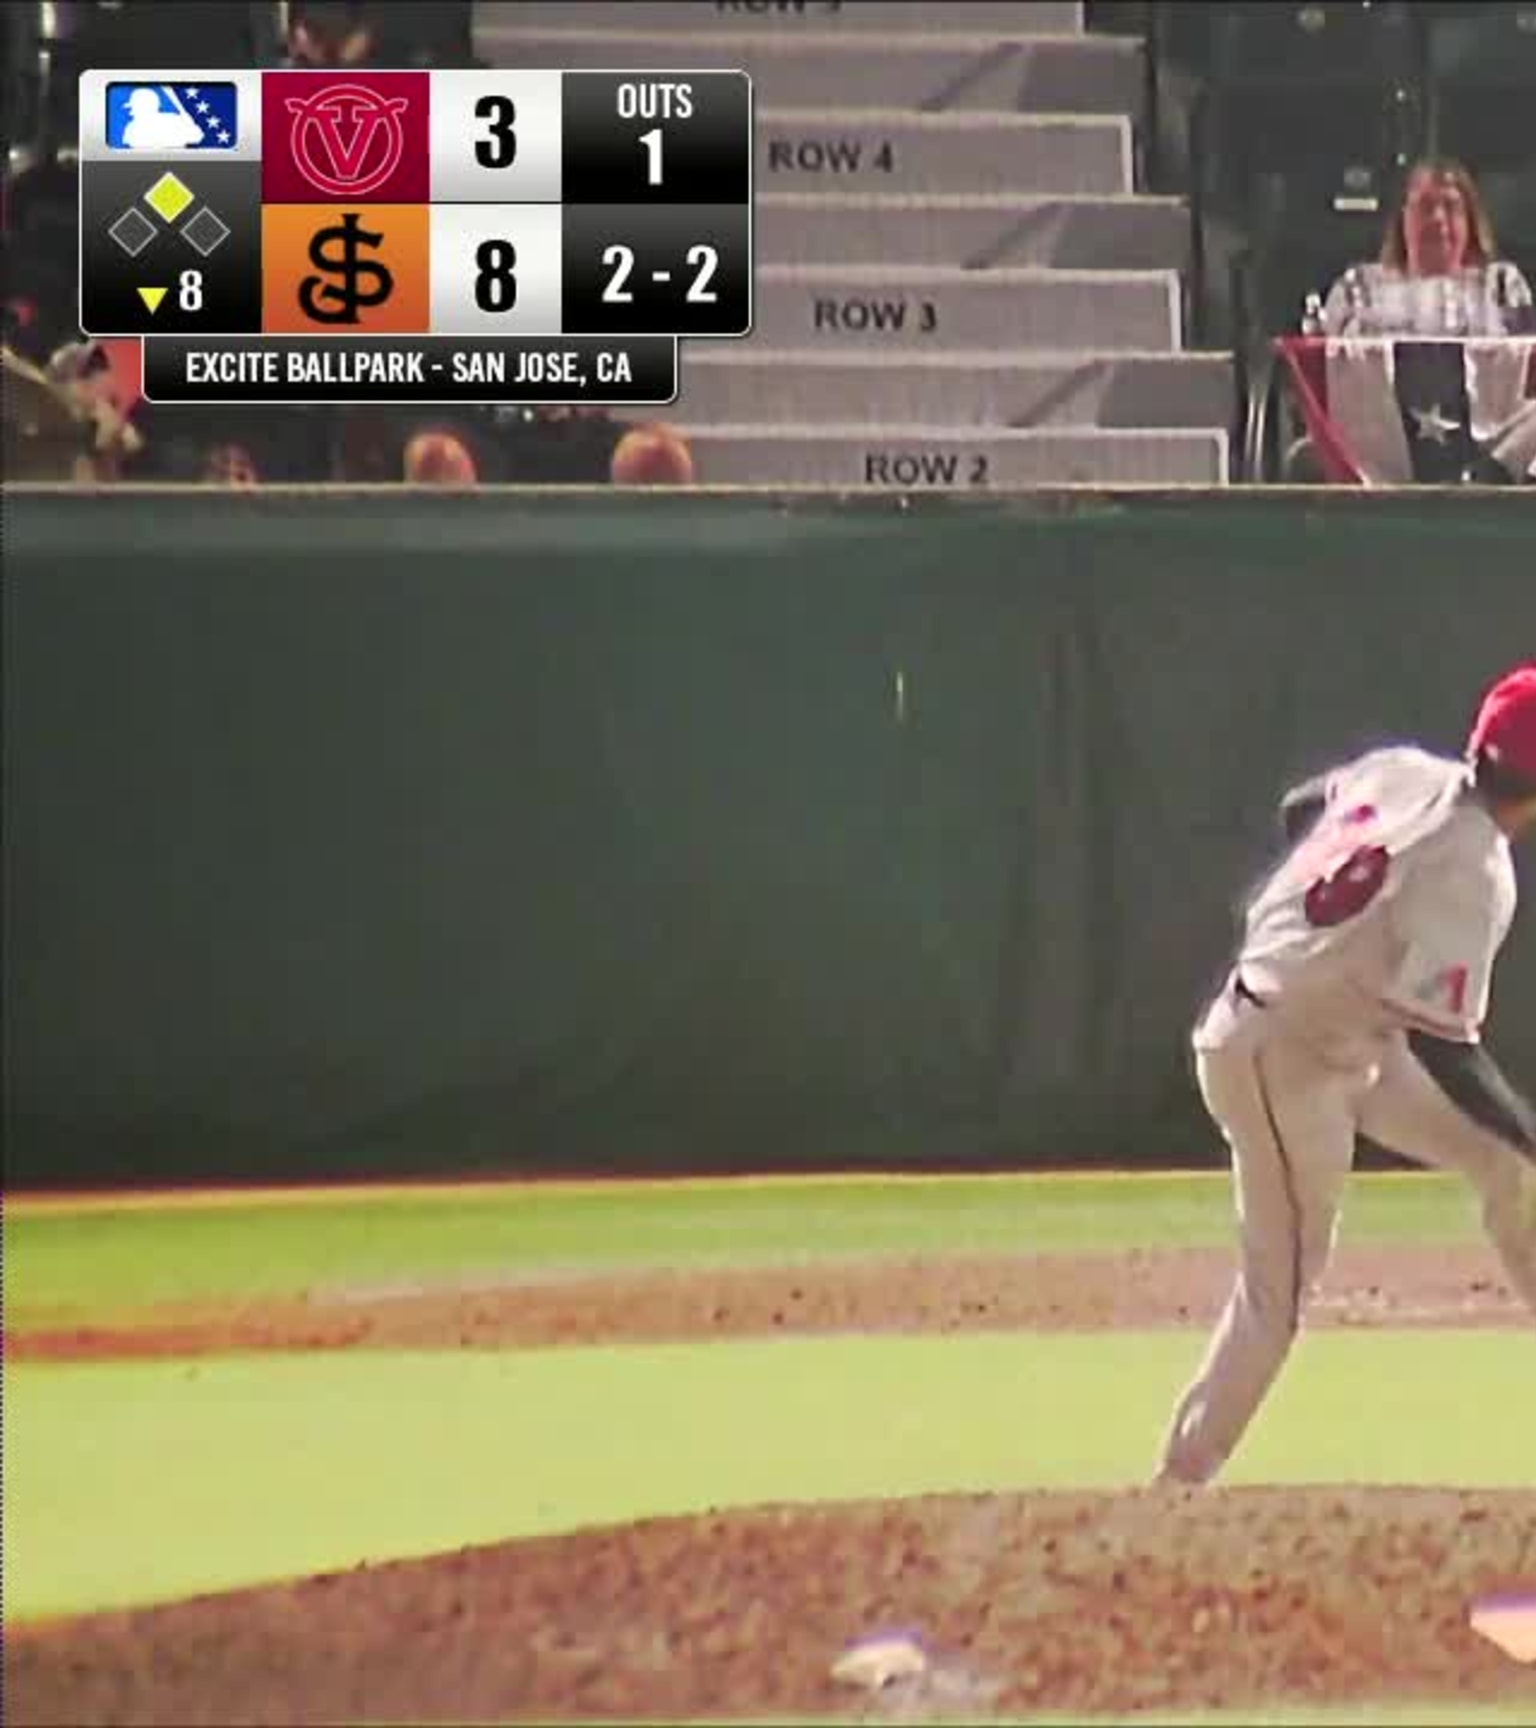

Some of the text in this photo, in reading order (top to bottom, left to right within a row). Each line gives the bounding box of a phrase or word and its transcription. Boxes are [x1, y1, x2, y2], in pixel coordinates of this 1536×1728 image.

[768, 140, 893, 172] ROW 4
[815, 301, 937, 331] ROW 3
[865, 455, 987, 484] ROW 2
